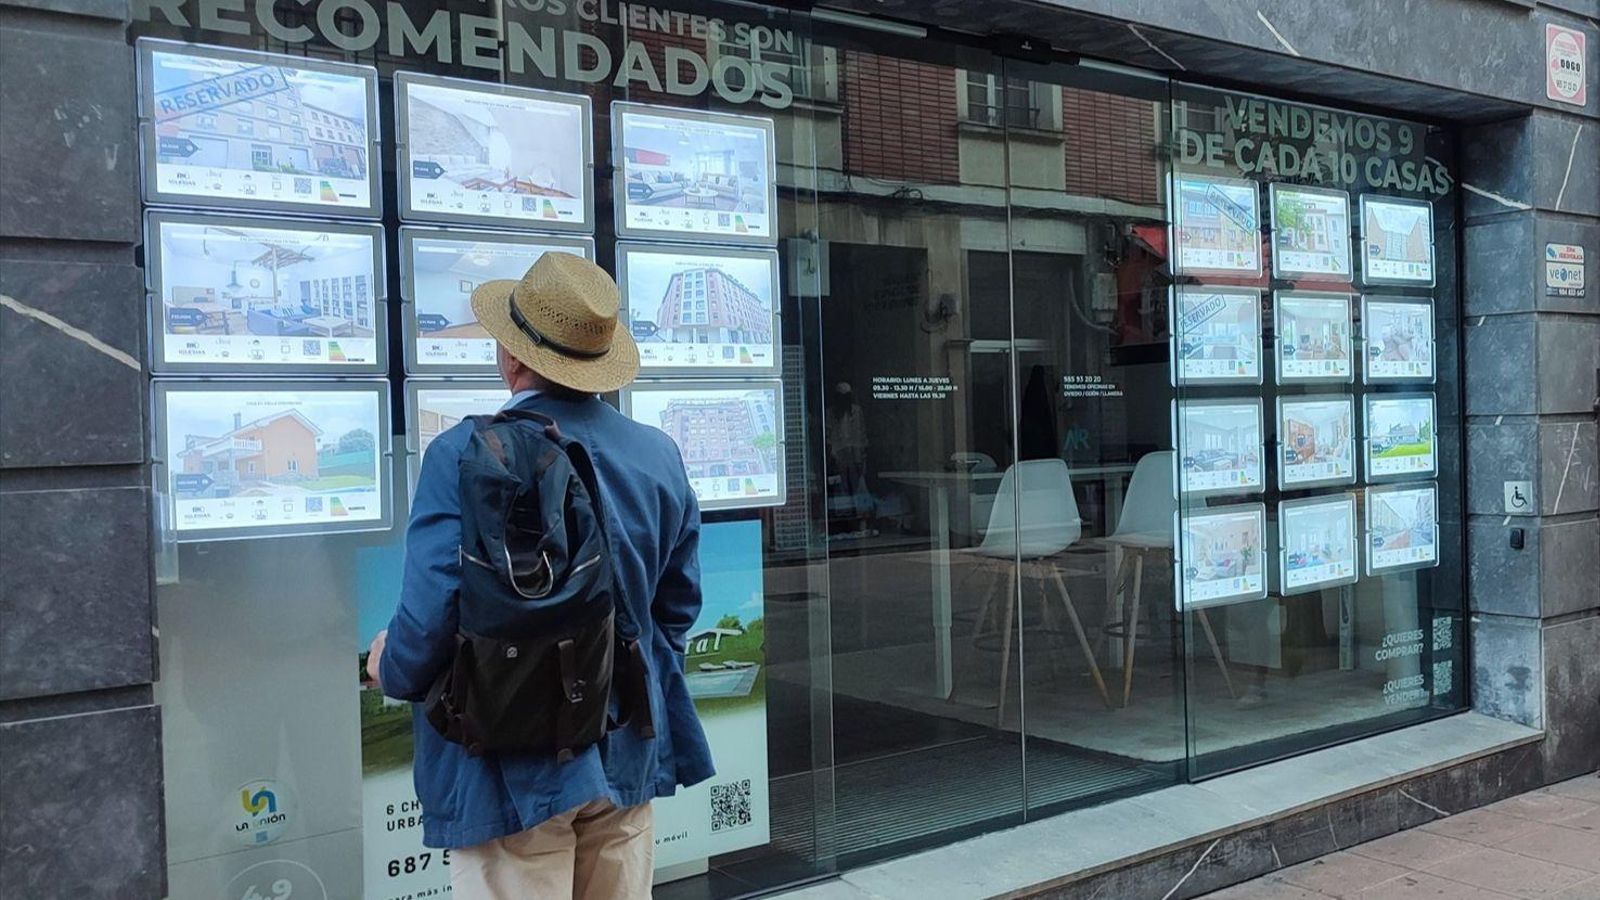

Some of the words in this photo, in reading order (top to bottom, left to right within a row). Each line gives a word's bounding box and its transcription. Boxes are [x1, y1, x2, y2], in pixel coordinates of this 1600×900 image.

[577, 0, 727, 42] CLIENTES
[734, 22, 794, 53] SON
[160, 73, 276, 114] RESERVADO
[1224, 96, 1392, 153] VENDEMOS
[1398, 126, 1414, 155] 9
[1180, 129, 1226, 168] DE
[1234, 138, 1322, 182] CADA
[1328, 152, 1357, 185] 10
[1365, 159, 1450, 196] CASAS
[1382, 629, 1424, 648] ¿QUIERES
[1375, 643, 1424, 661] COMPRAR?
[1383, 674, 1425, 694] ¿QUIERES
[386, 804, 395, 816] 6
[664, 831, 688, 843] móvil
[388, 852, 431, 878] 687
[417, 888, 439, 899] más
